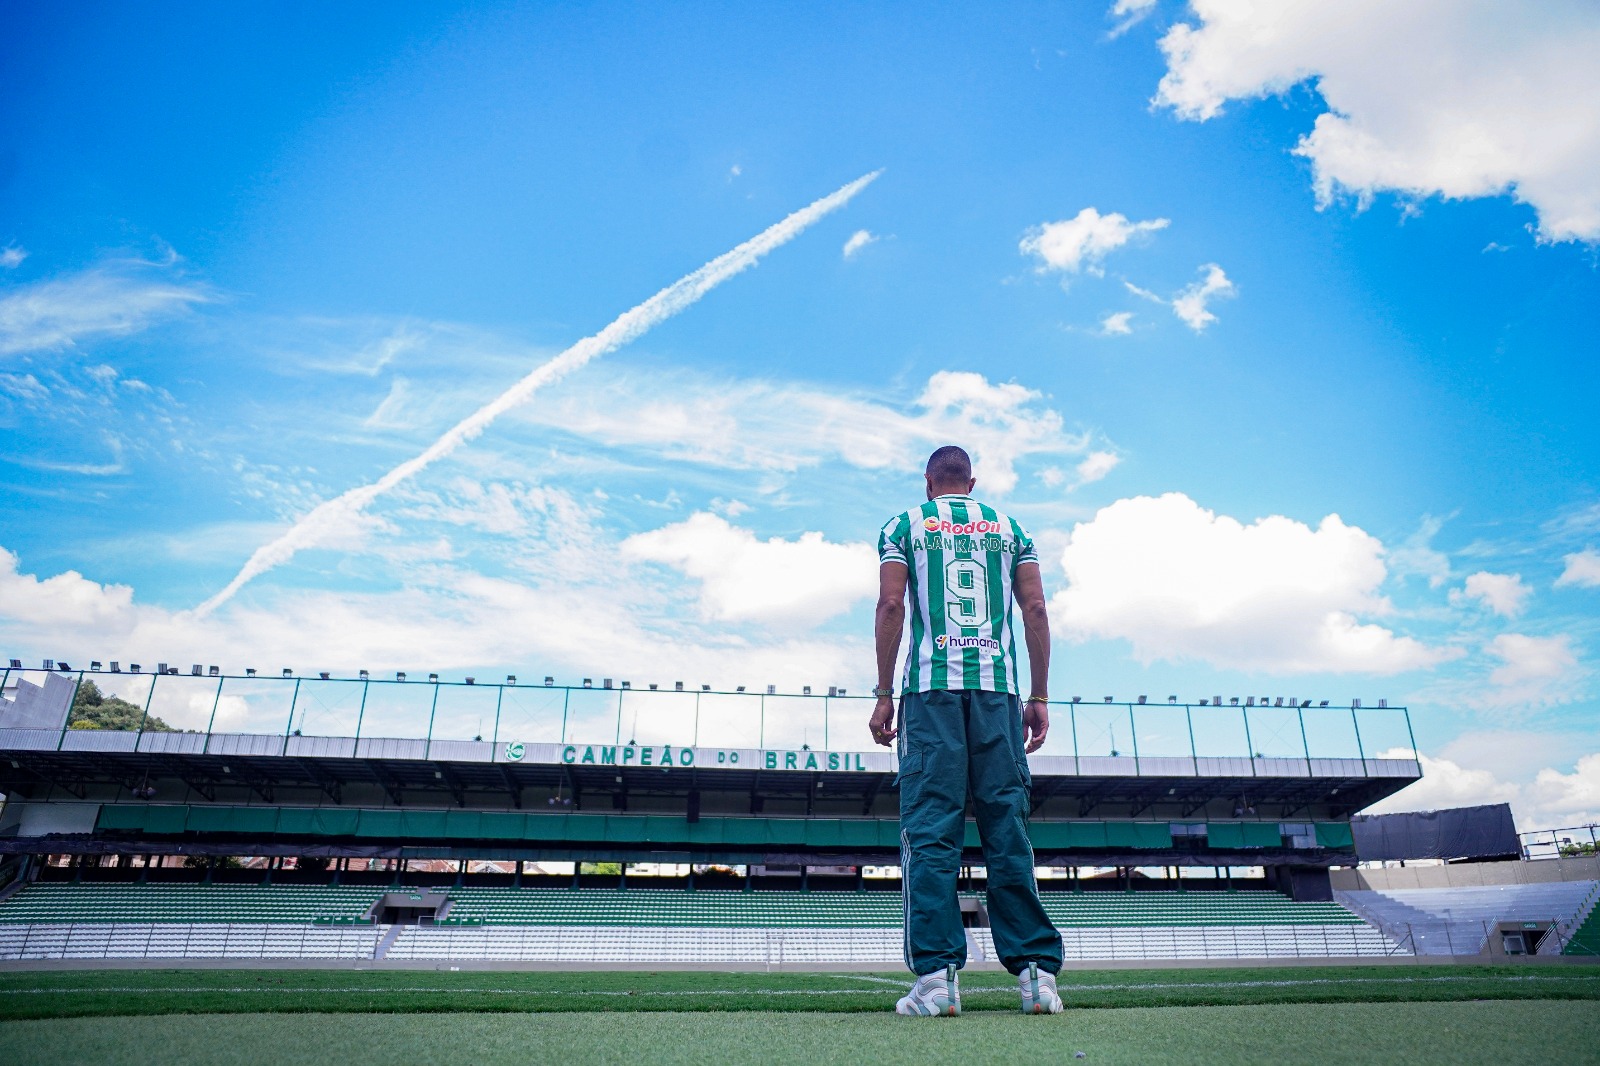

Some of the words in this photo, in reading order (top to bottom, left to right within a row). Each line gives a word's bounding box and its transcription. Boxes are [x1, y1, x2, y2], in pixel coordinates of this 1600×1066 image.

[940, 520, 1001, 535] RodOil
[913, 536, 953, 551] ALAN
[954, 538, 1017, 555] KARDEC
[945, 558, 989, 627] 9
[949, 635, 999, 650] humana
[563, 745, 695, 766] CAMPEÃO
[717, 751, 739, 763] DO
[765, 751, 866, 771] BRASIL
